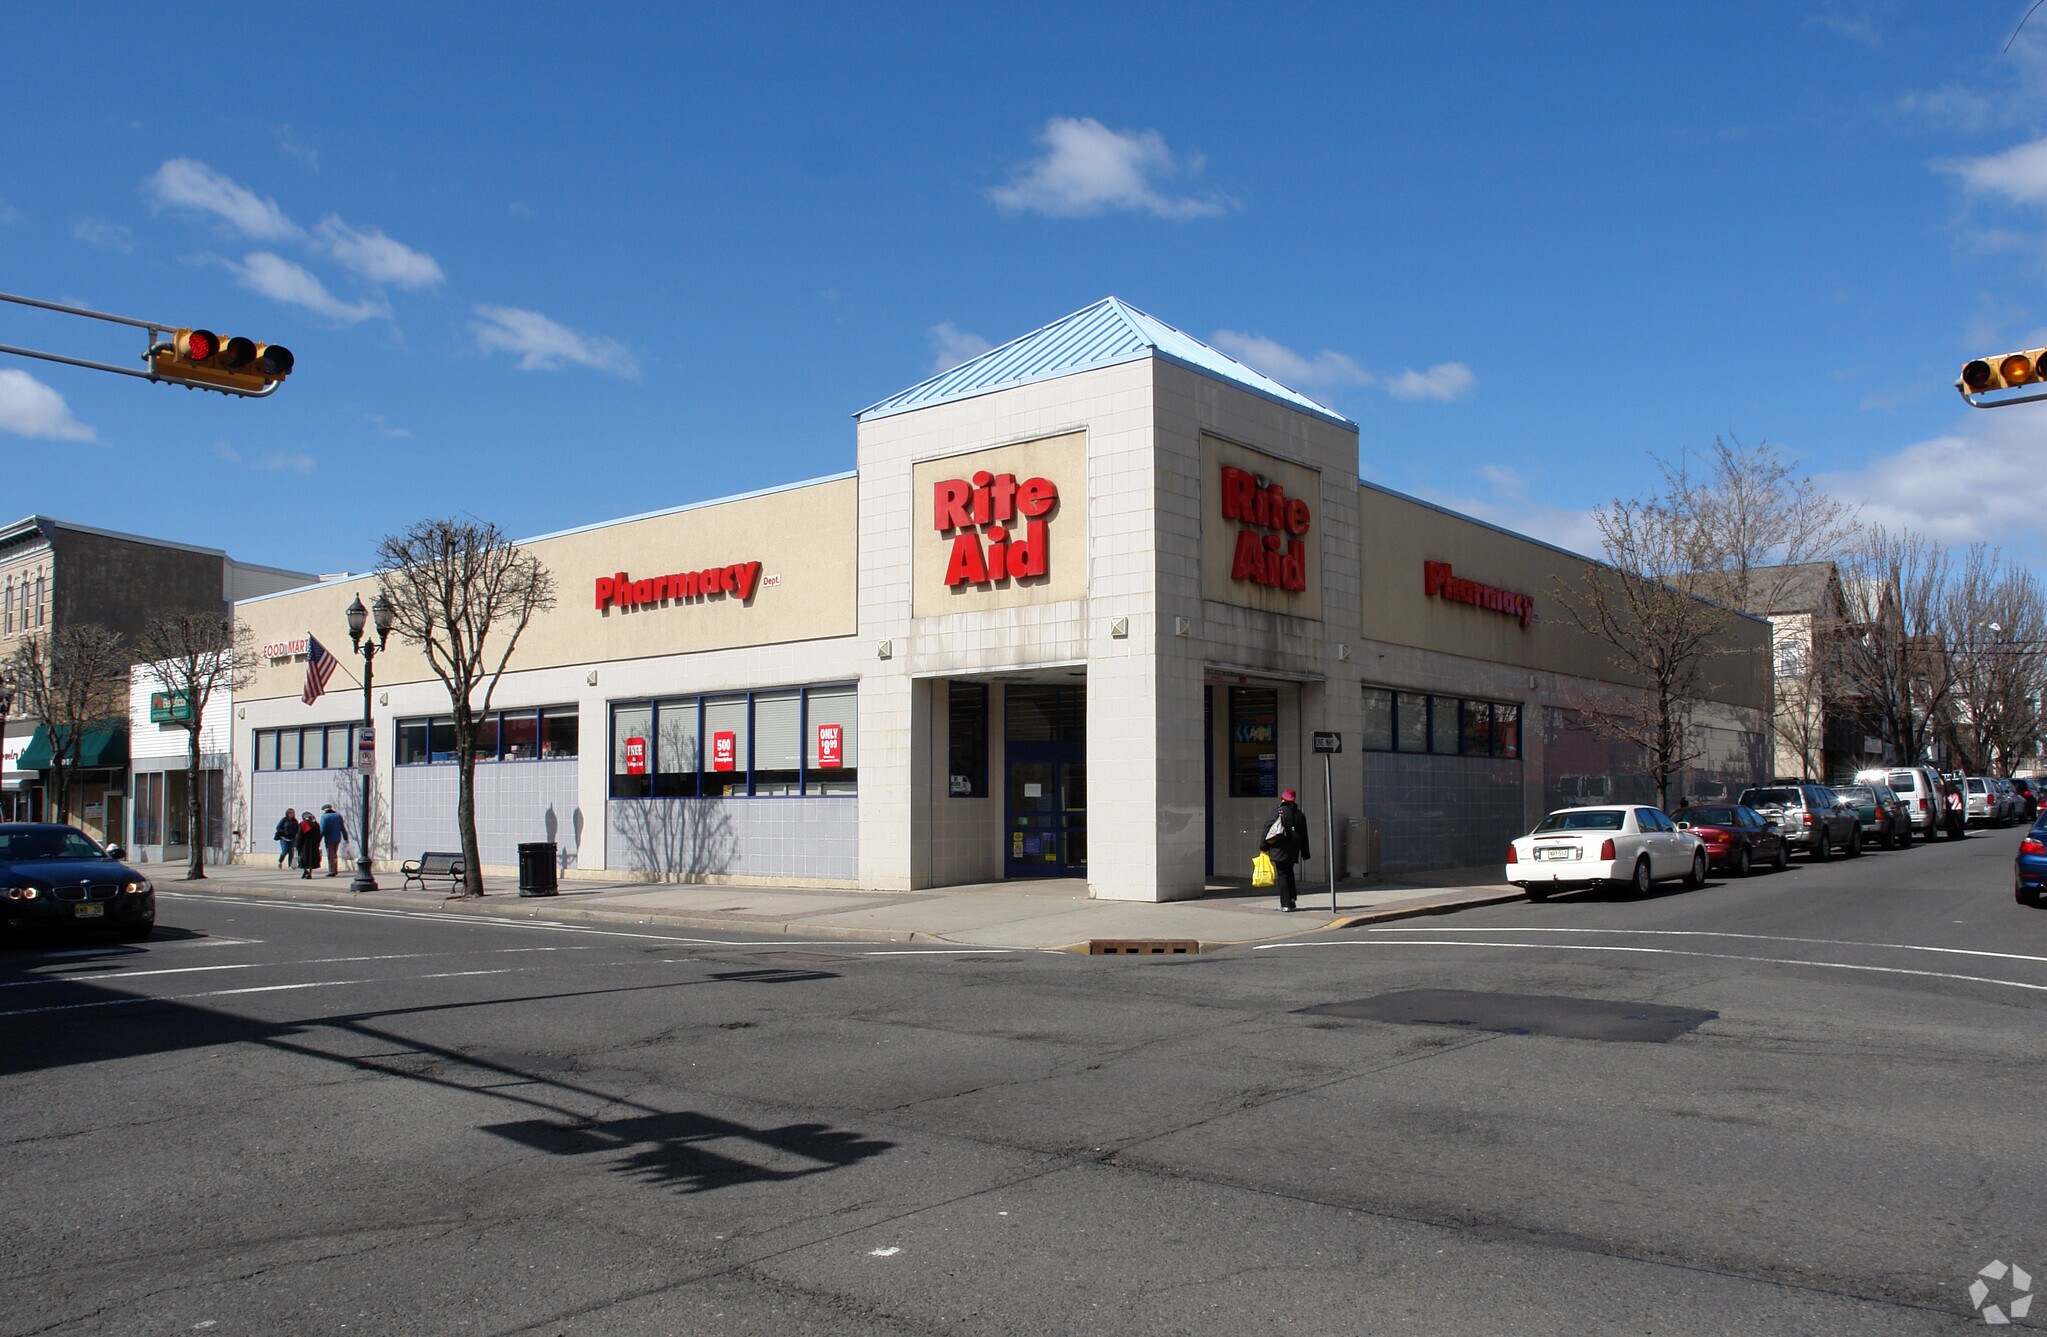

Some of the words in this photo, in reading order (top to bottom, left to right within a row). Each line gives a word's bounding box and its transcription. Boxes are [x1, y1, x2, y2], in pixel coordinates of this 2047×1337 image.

[934, 470, 1059, 531] Rite
[1221, 466, 1310, 536] Rite
[944, 519, 1048, 586] Aid
[1231, 530, 1306, 592] Aid
[595, 561, 763, 610] Pharmacy
[1423, 560, 1535, 628] Pharmacy
[263, 642, 285, 658] FOOD
[287, 639, 309, 654] MART
[627, 744, 643, 756] FREE
[717, 739, 731, 751] 500
[820, 727, 839, 740] ONLY
